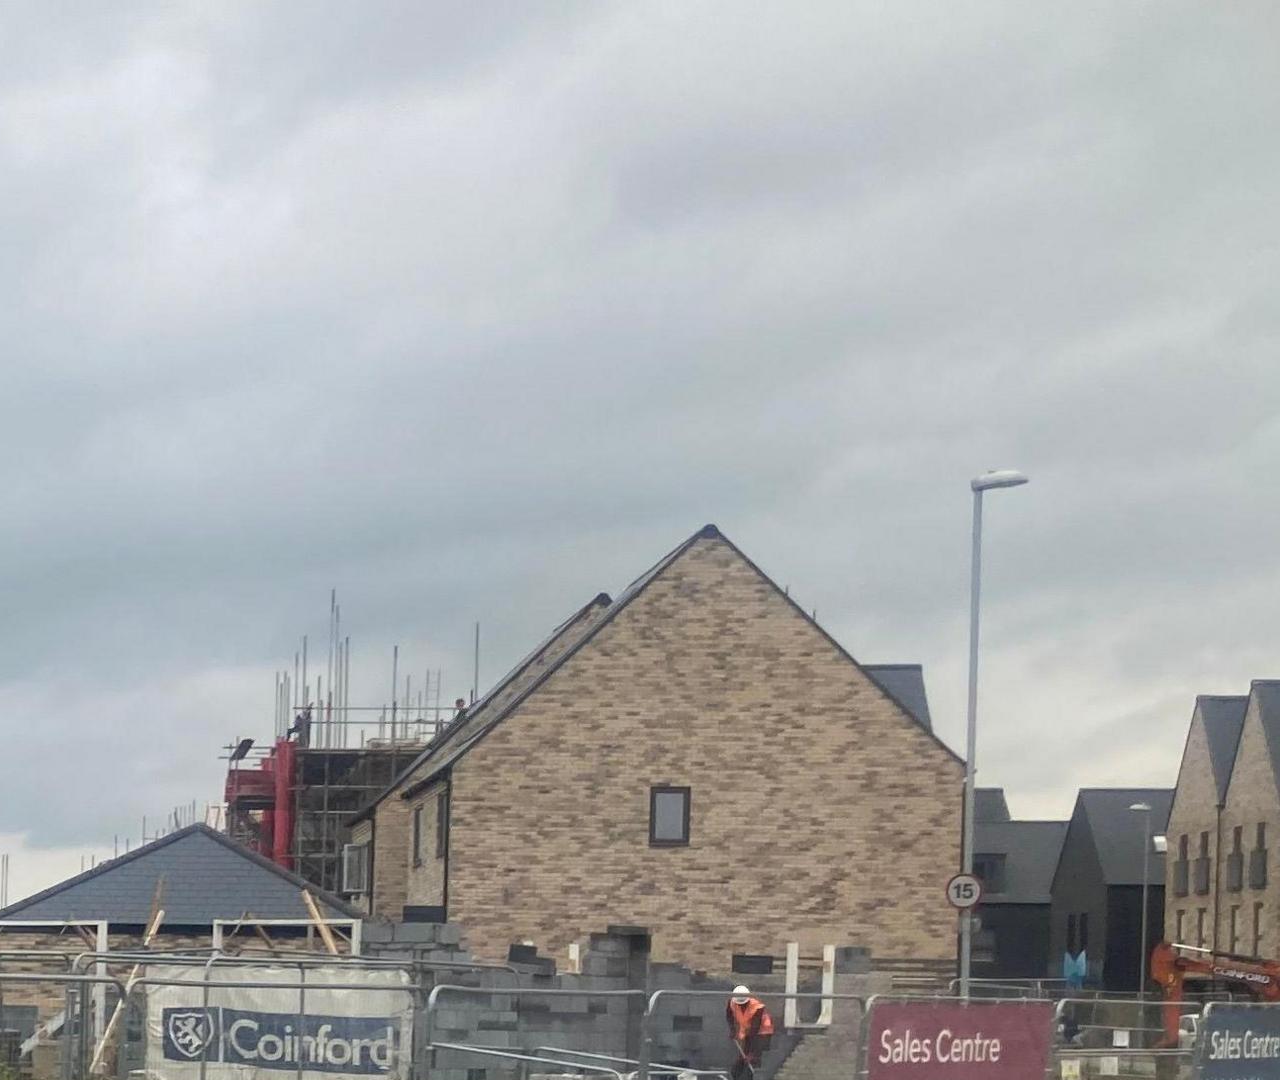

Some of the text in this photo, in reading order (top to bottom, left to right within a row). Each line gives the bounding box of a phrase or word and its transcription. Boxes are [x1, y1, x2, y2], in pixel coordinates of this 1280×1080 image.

[952, 883, 974, 899] 15
[229, 1018, 394, 1068] Coinford
[878, 1029, 1001, 1064] Sales Centre
[1209, 1030, 1280, 1060] Sales Centre
